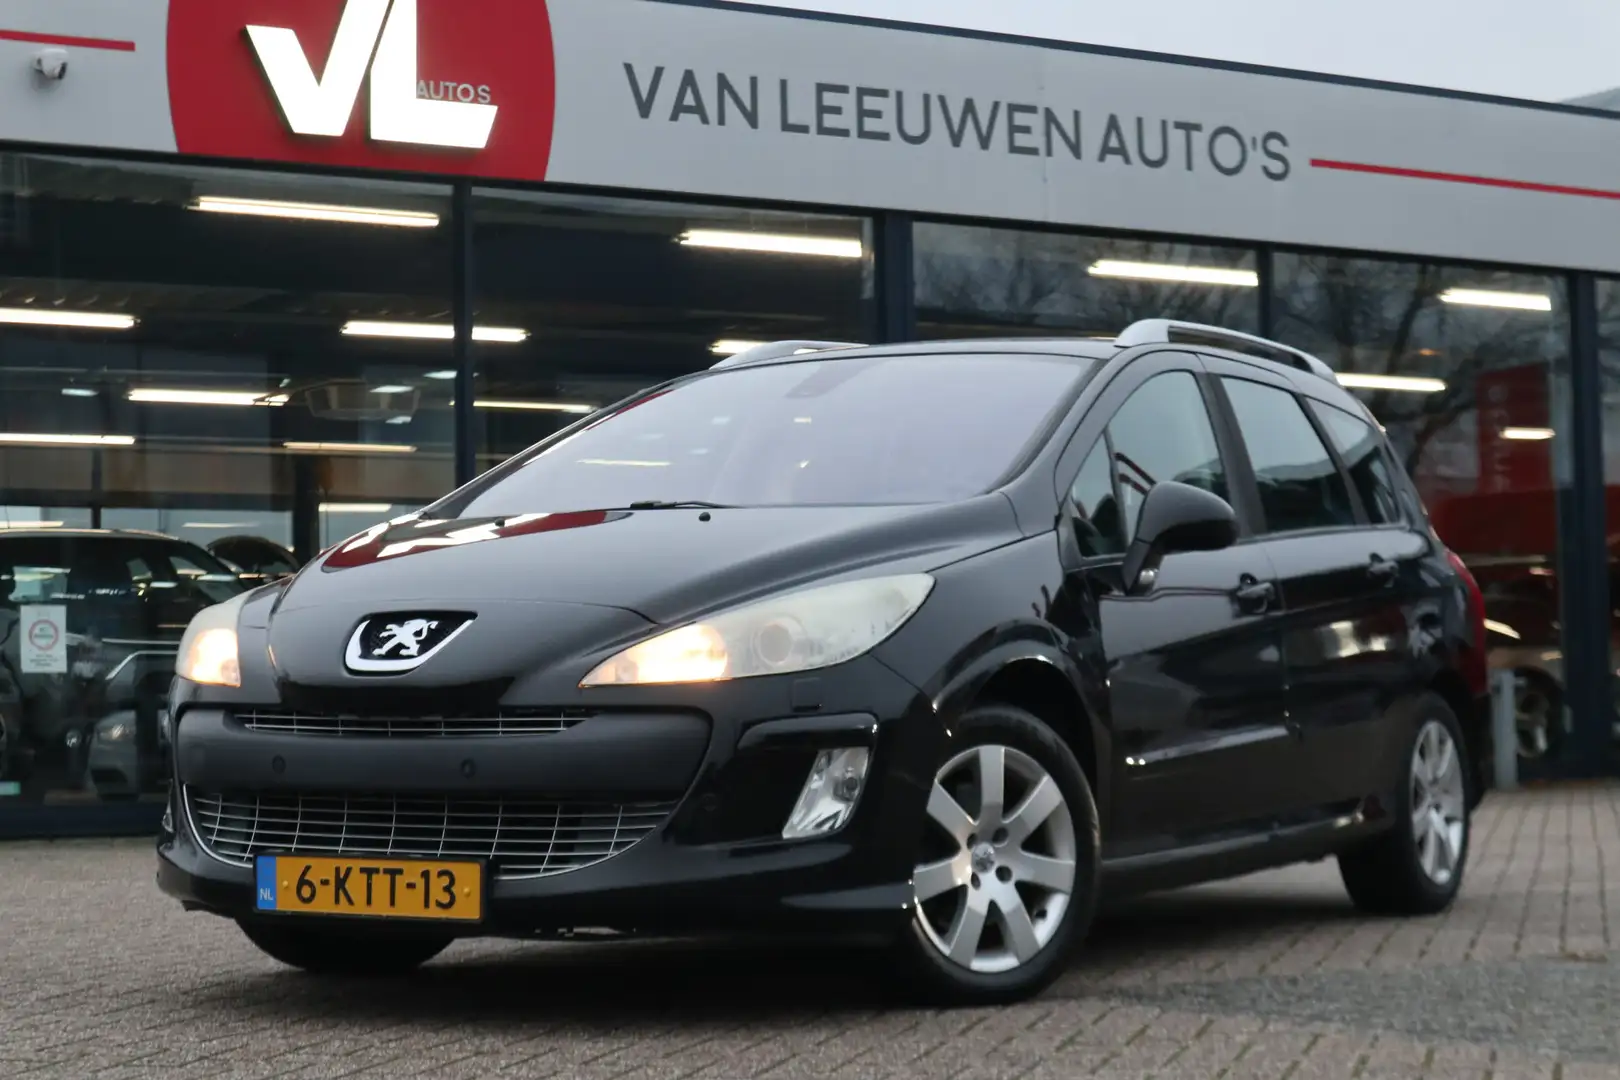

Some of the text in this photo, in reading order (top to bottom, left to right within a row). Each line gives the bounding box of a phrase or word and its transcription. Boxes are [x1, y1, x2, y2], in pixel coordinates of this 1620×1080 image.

[416, 80, 491, 104] AUTOS
[623, 63, 1290, 181] VAN LEEUWEN AUTO'S
[259, 888, 273, 901] NL
[296, 864, 456, 909] 6-KTT-13
